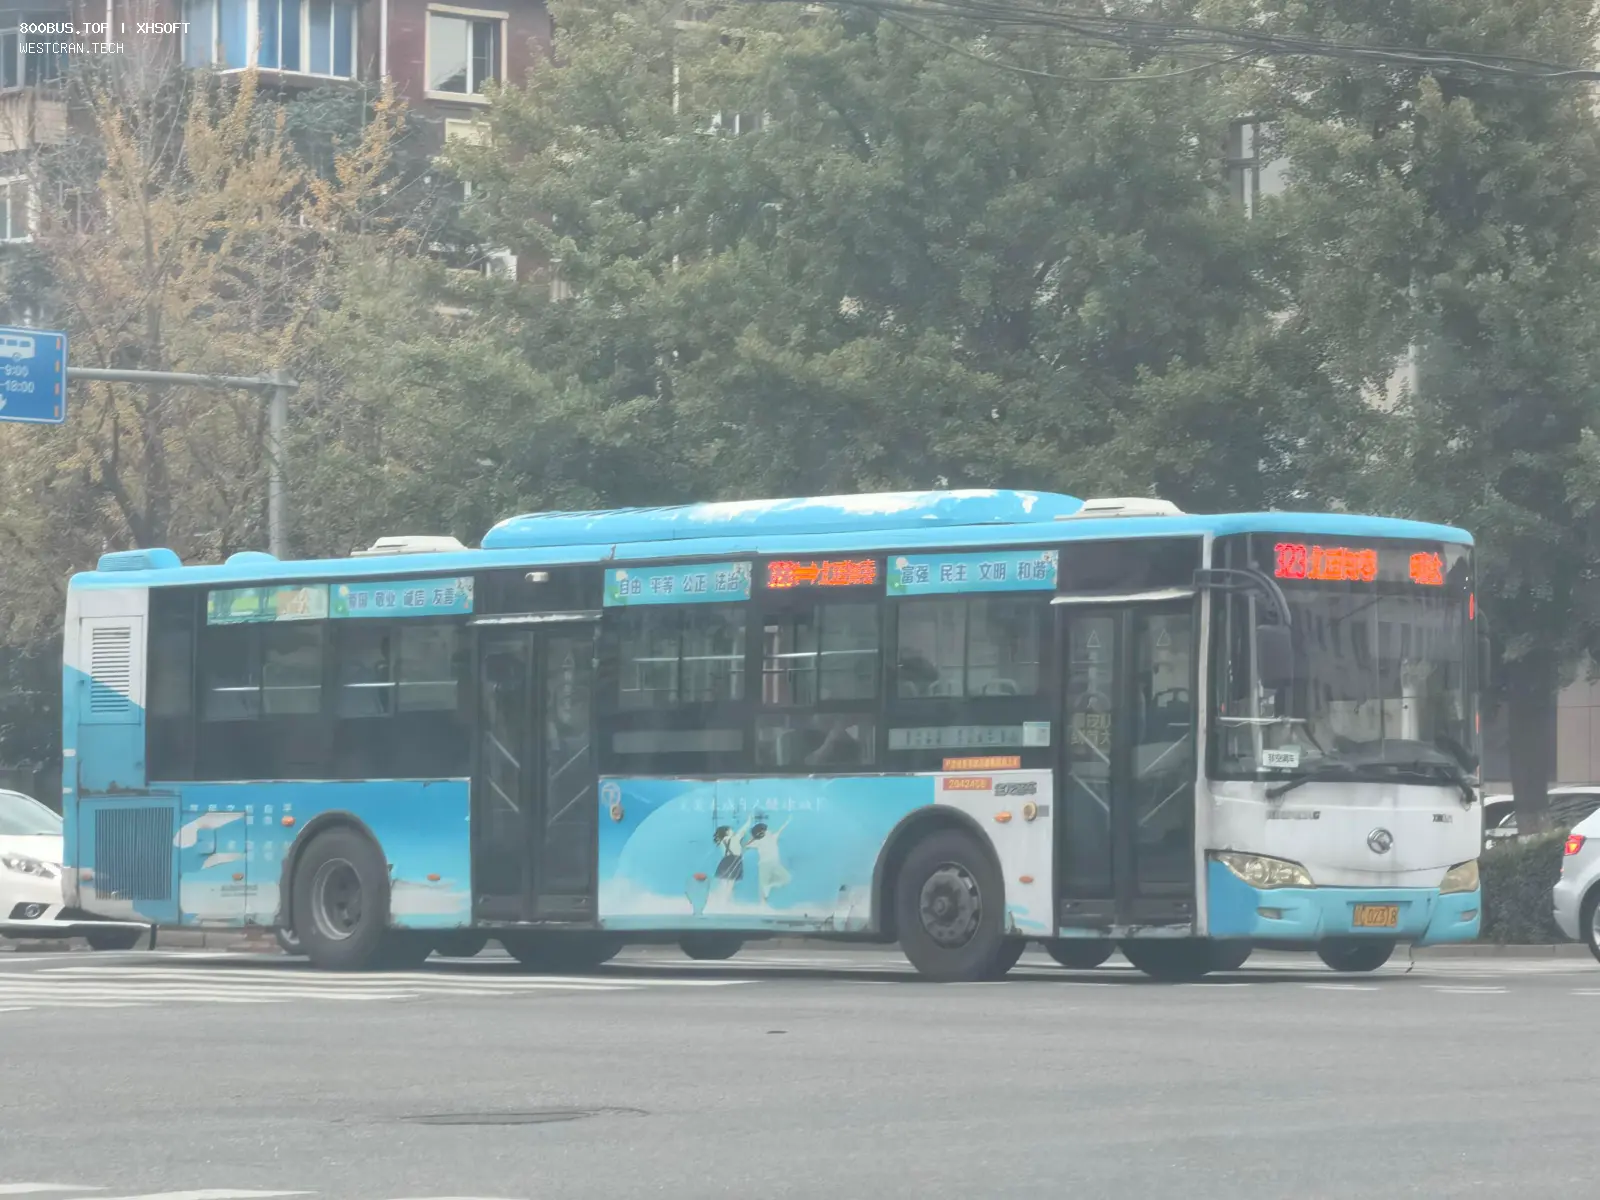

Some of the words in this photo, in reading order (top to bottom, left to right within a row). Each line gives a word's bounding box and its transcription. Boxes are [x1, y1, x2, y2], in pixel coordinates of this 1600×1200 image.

[901, 564, 929, 585] 富强
[940, 563, 968, 582] 民主
[978, 561, 1007, 581] 文明
[1017, 559, 1047, 580] 和谐
[1274, 543, 1306, 578] 323
[403, 588, 425, 607] 诚信
[432, 586, 456, 606] 友善
[618, 577, 642, 596] 自由
[649, 576, 673, 594] 平等
[682, 573, 707, 593] 公正
[714, 572, 741, 592] 法治
